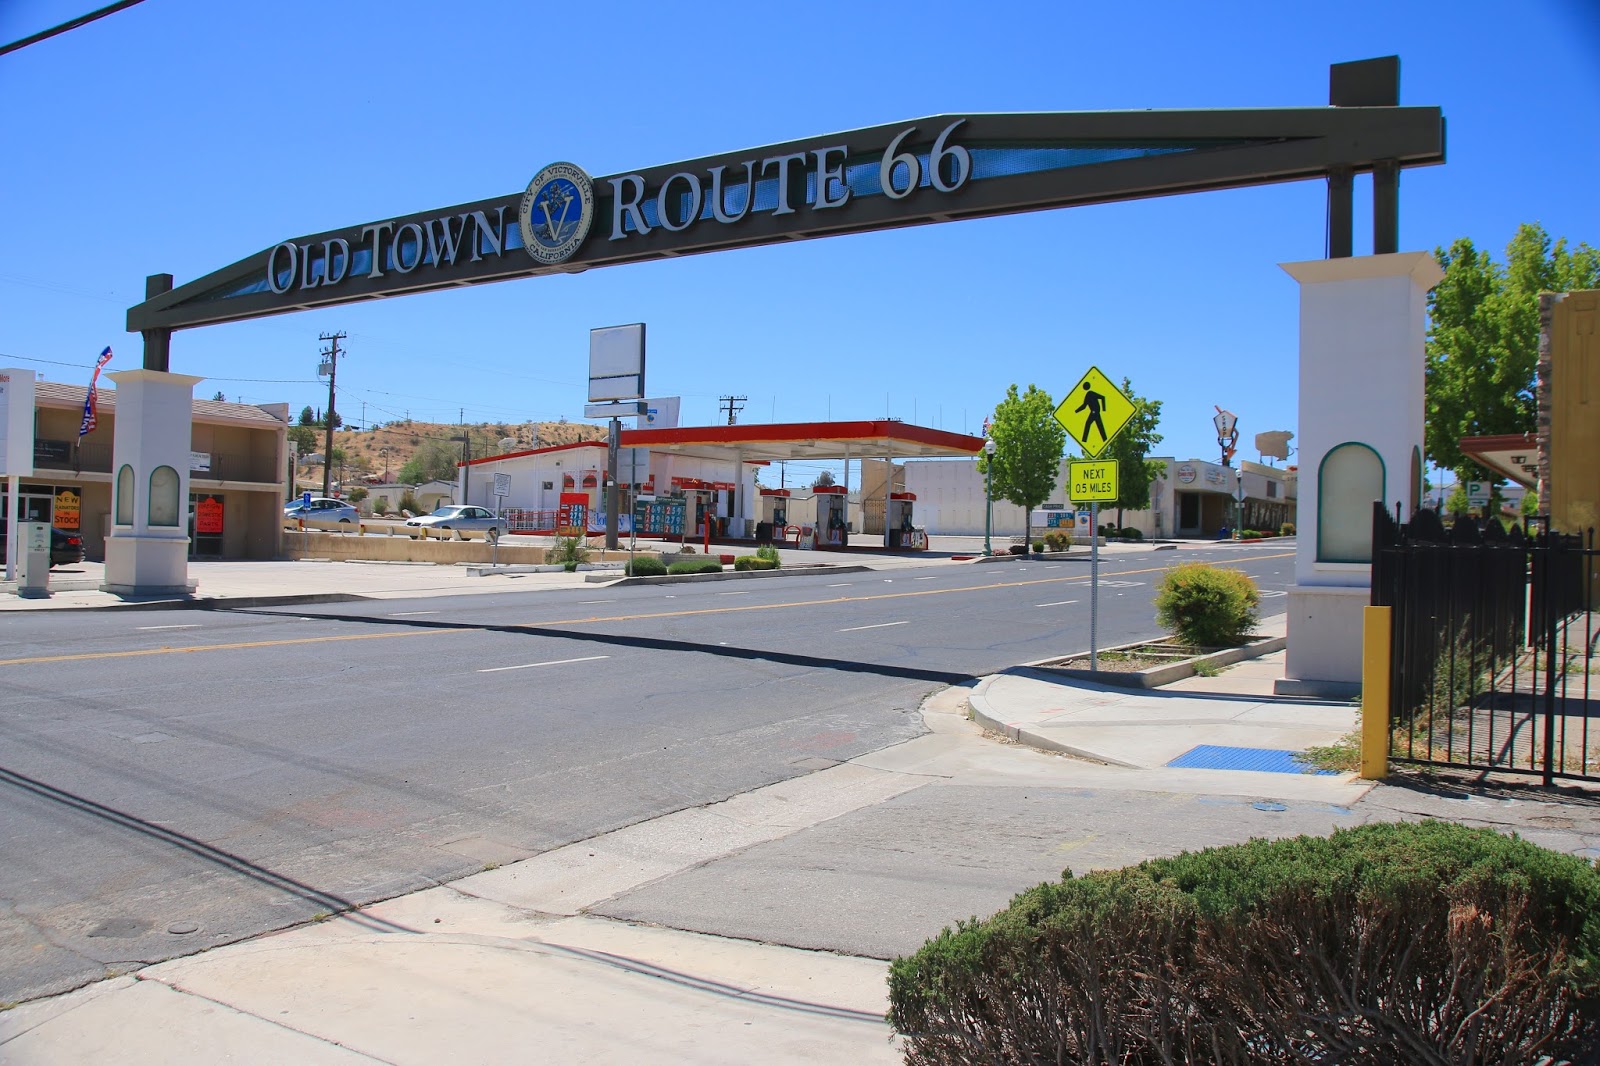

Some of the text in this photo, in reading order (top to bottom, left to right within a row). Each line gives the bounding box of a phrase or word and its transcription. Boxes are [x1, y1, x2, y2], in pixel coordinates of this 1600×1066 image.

[534, 174, 545, 187] OF
[548, 166, 591, 205] VICTORVILLE
[267, 118, 972, 295] OLD TOWN ROUTE 66
[540, 195, 574, 241] V
[529, 238, 580, 260] CALIFORNIA
[1075, 482, 1111, 493] 0.5 MILES
[1083, 468, 1105, 479] NEXT
